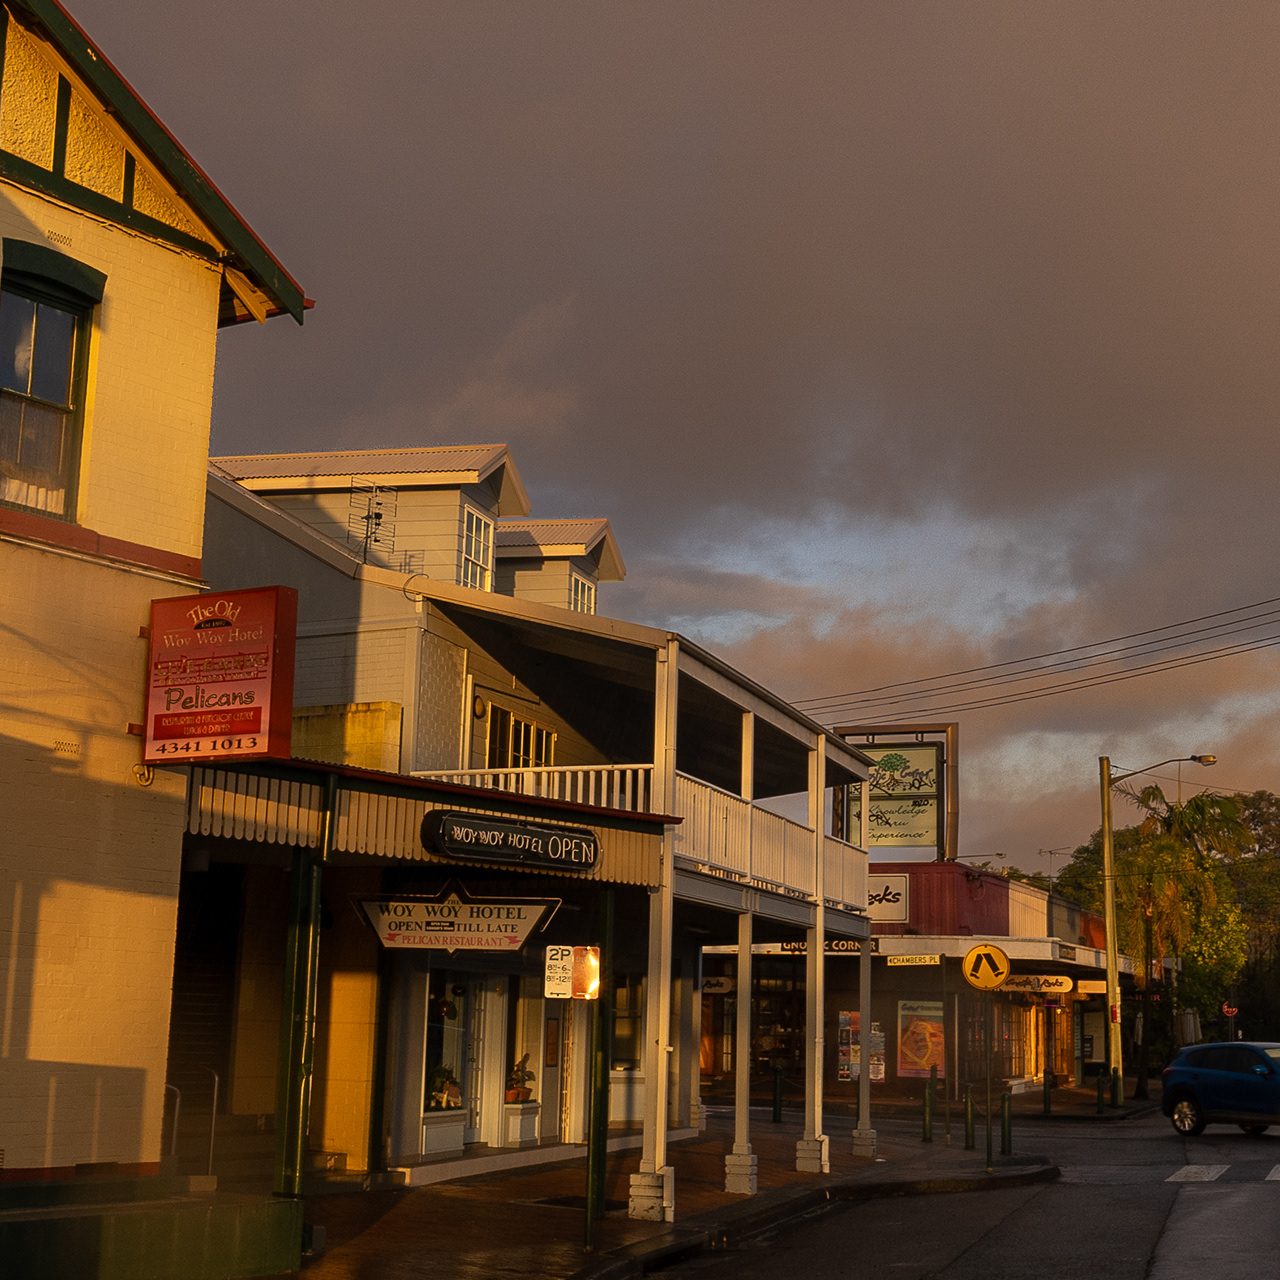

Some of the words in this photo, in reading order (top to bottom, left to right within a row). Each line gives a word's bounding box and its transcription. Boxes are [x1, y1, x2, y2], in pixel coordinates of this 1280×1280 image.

[186, 604, 214, 625] The
[214, 599, 242, 622] Old
[164, 685, 256, 711] Pelicans
[155, 741, 201, 754] 4341
[210, 737, 257, 751] 1013
[451, 825, 477, 844] WOY
[478, 829, 504, 846] WOY
[508, 832, 544, 854] HOTEL
[548, 835, 595, 864] OPEN
[868, 885, 902, 906] ocks
[379, 904, 417, 917] WOY
[425, 905, 463, 918] WOY
[469, 906, 528, 920] HOTEL
[388, 921, 423, 932] OPEN
[454, 923, 484, 933] TILL
[487, 923, 518, 933] LATE
[402, 935, 441, 945] PELICAN
[442, 936, 504, 947] RESTAURANT
[783, 940, 829, 951] GNOC
[831, 940, 876, 951] CORNR
[549, 948, 571, 961] 2P
[893, 956, 927, 964] CHAMBERS
[929, 955, 938, 963] PL
